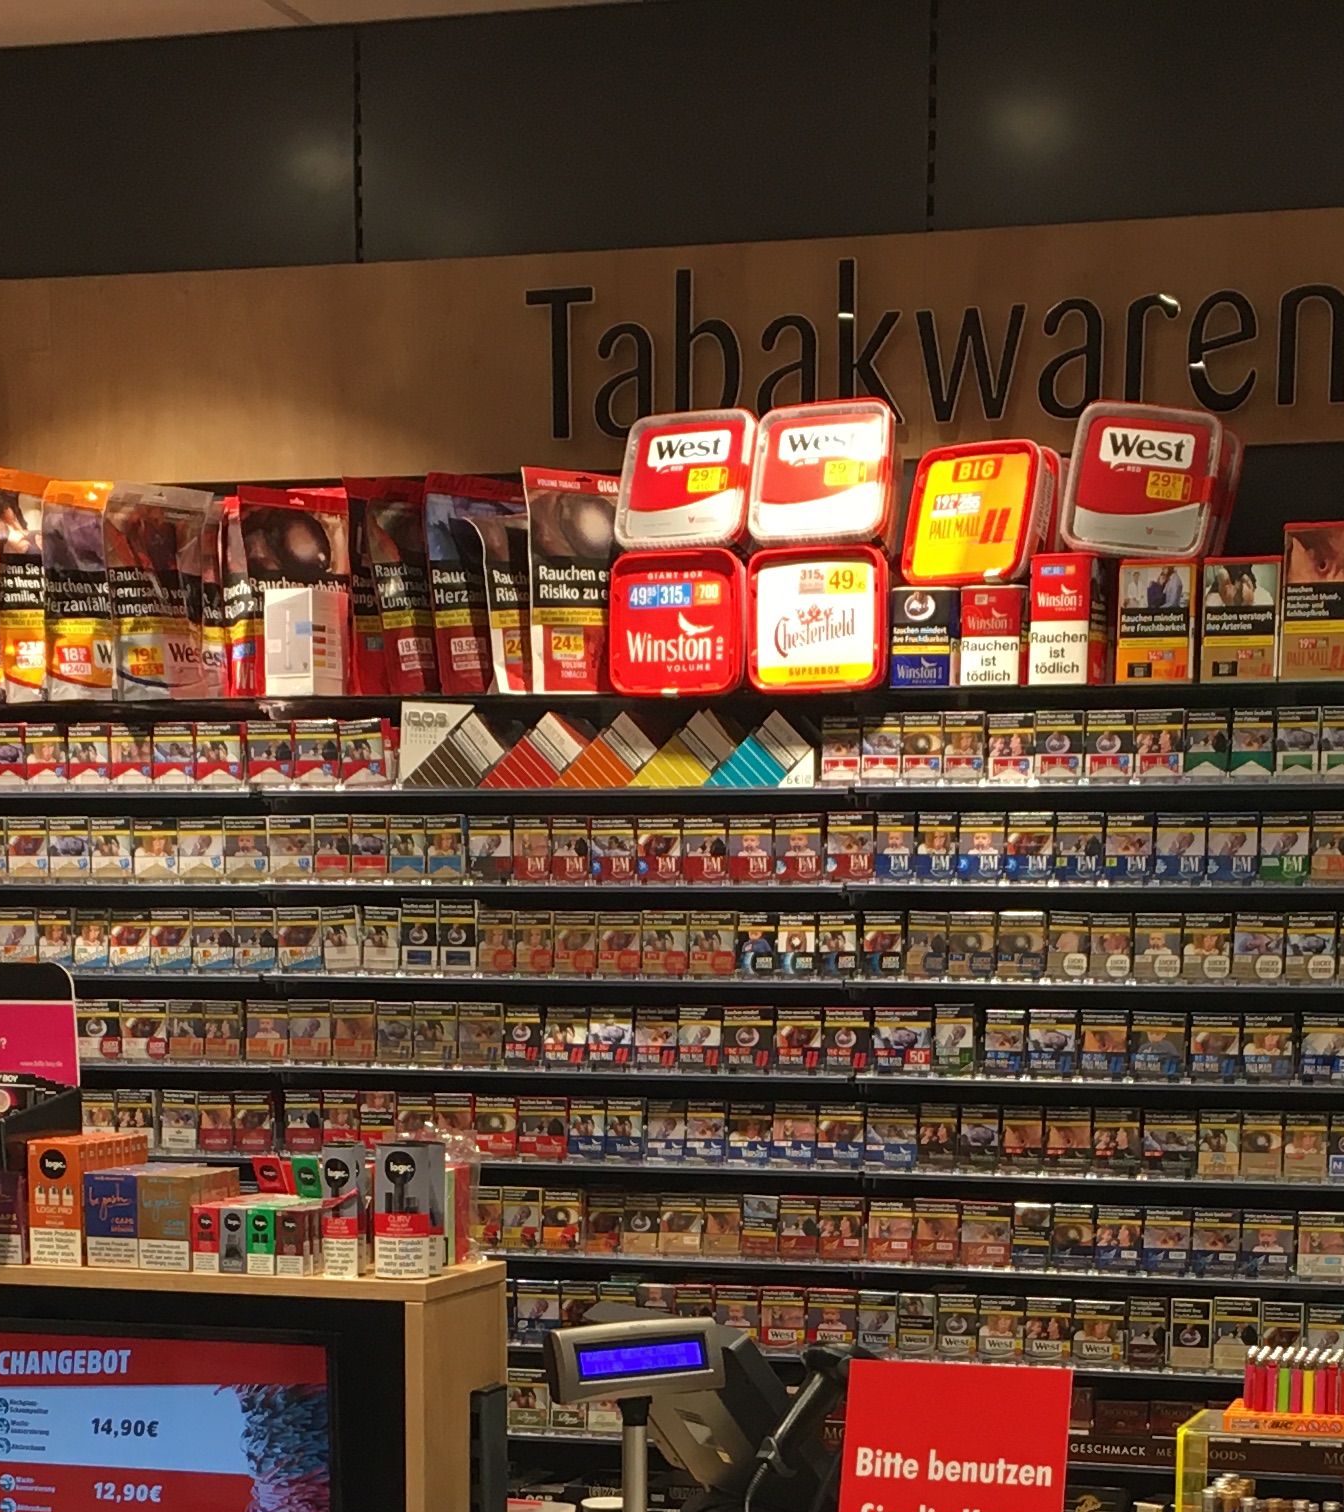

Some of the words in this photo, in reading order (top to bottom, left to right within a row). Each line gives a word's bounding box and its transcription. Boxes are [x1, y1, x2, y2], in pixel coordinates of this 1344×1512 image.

[656, 437, 721, 460] West
[1108, 432, 1186, 463] West
[958, 460, 995, 481] BIG
[930, 517, 952, 540] PALL
[953, 516, 980, 539] MALL
[539, 565, 591, 582] Rauchen
[684, 571, 703, 579] BOX
[540, 585, 580, 600] Risiko
[582, 587, 598, 600] zu
[1037, 593, 1078, 608] Winston
[1121, 614, 1153, 623] Rauchen
[1154, 613, 1184, 623] mindert
[774, 608, 855, 659] Chesterfield
[1031, 631, 1087, 644] Rauchen
[627, 629, 711, 663] Winston
[961, 639, 1018, 653] Rauchen
[1049, 646, 1066, 659] ist
[667, 663, 711, 672] VOLUME
[980, 655, 997, 667] ist
[1035, 659, 1080, 675] tödlich
[789, 666, 840, 677] SUPERBOX
[966, 667, 1010, 683] tödlich
[90, 1417, 160, 1440] 14,90€
[1070, 1443, 1146, 1457] GESCHMACK
[855, 1446, 919, 1480] Bitte
[928, 1449, 1053, 1487] benutzen
[94, 1480, 163, 1504] 12,90€
